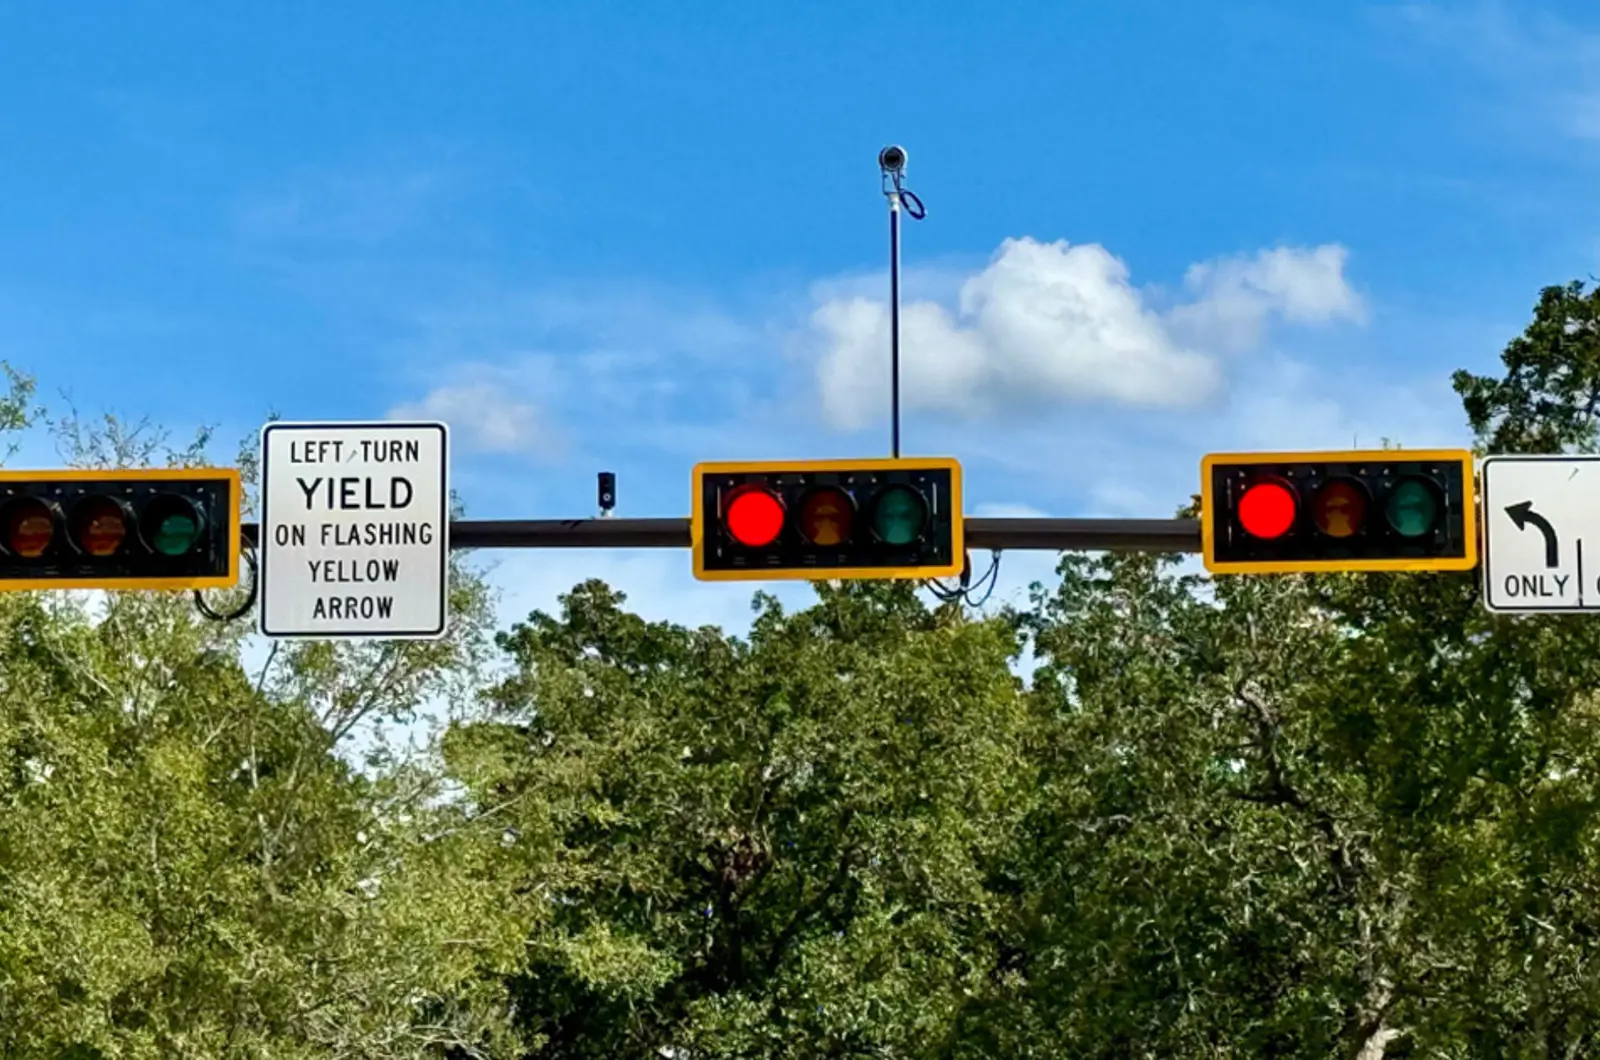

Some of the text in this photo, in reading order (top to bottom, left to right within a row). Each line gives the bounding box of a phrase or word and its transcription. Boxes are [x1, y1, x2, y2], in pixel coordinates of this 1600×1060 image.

[291, 440, 419, 463] LEFT TURN
[296, 476, 413, 510] YIELD
[275, 522, 432, 546] ON FLASHING
[308, 559, 399, 583] YELLOW
[1504, 574, 1569, 597] ONLY
[313, 596, 393, 619] ARROW
